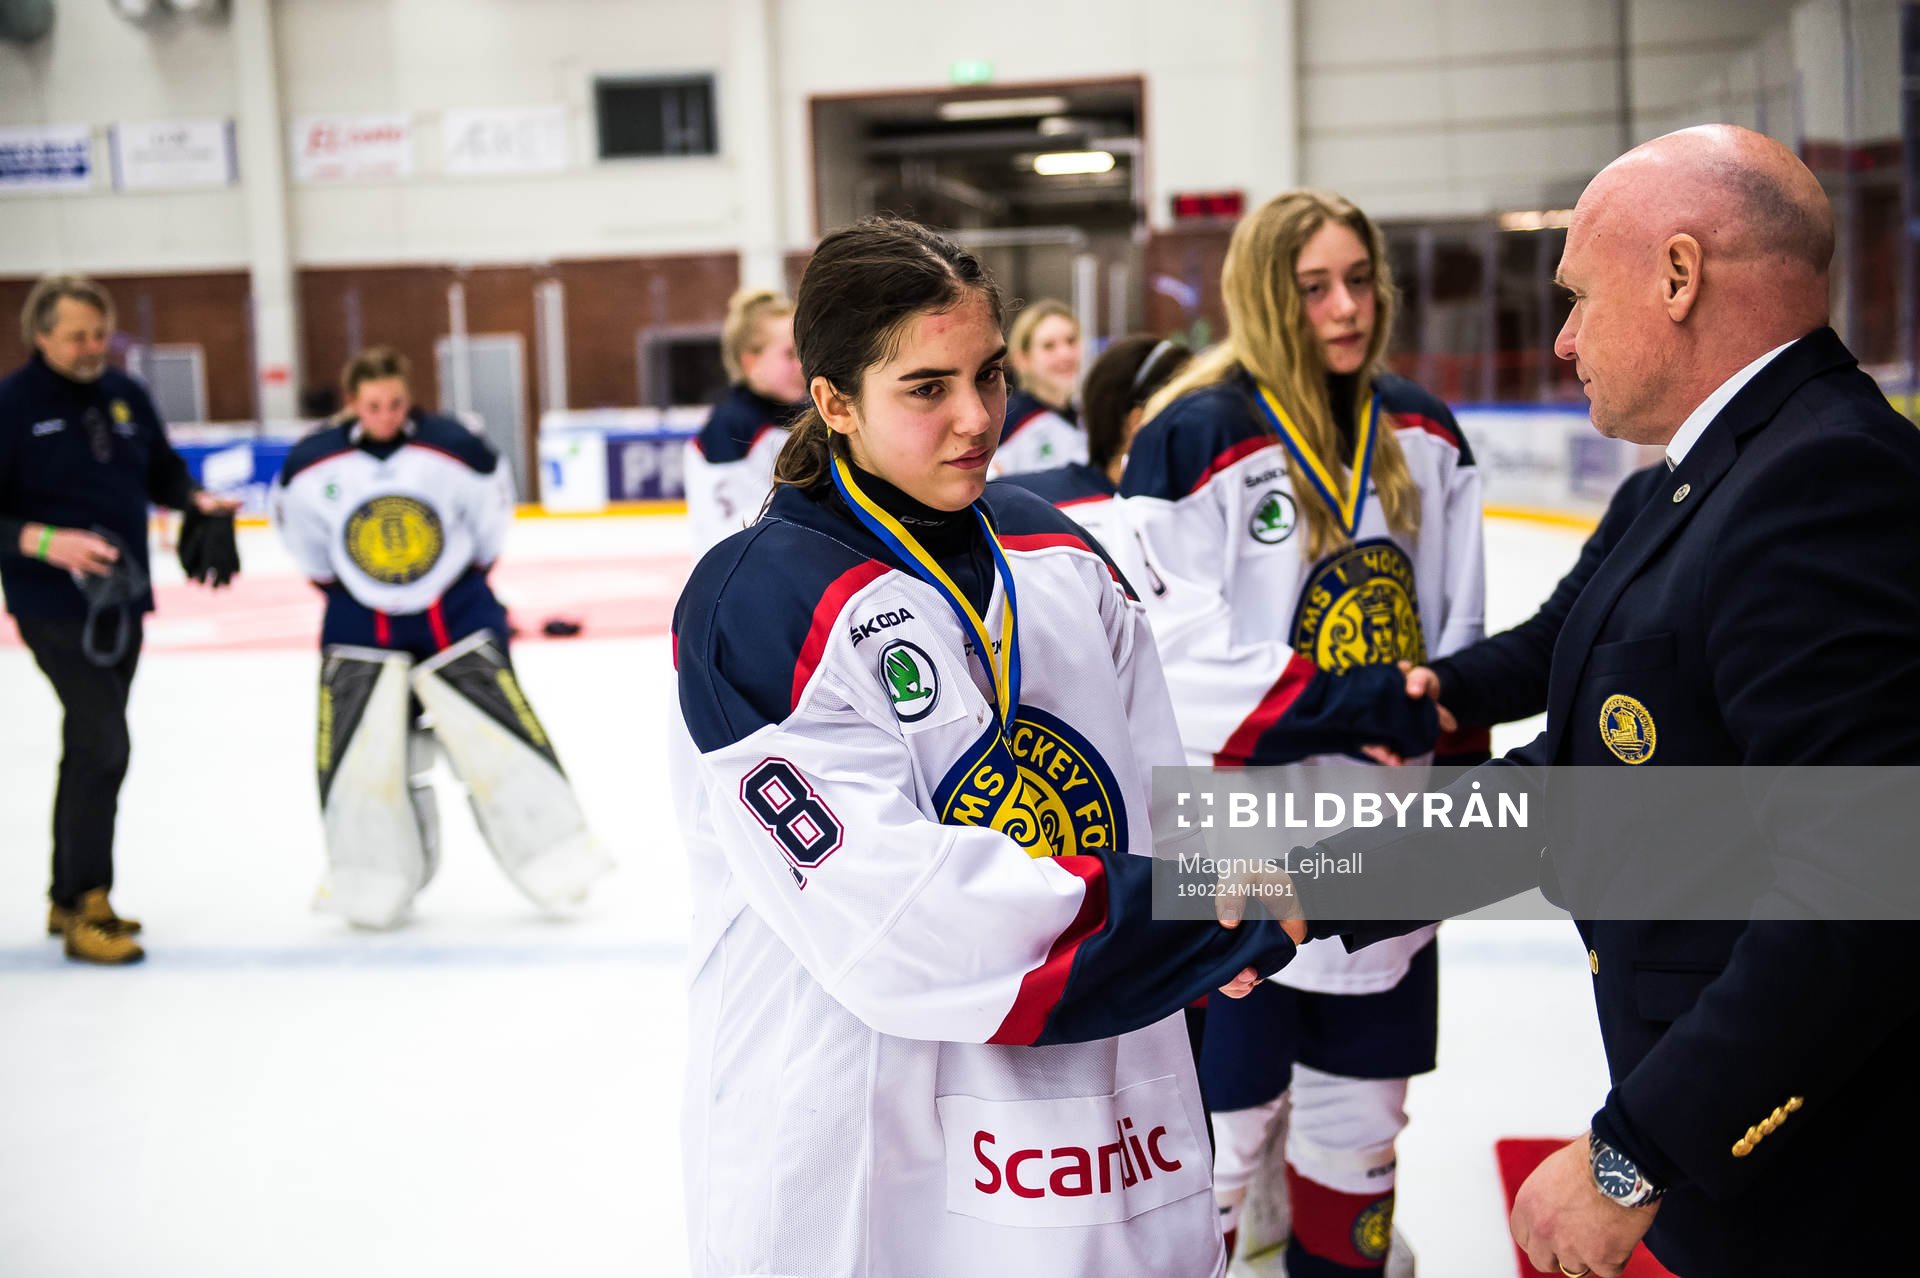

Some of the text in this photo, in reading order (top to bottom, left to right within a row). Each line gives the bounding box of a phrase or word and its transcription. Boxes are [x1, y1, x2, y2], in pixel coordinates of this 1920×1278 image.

[739, 756, 845, 869] 8
[952, 727, 1109, 849] MS CKEY FÖ
